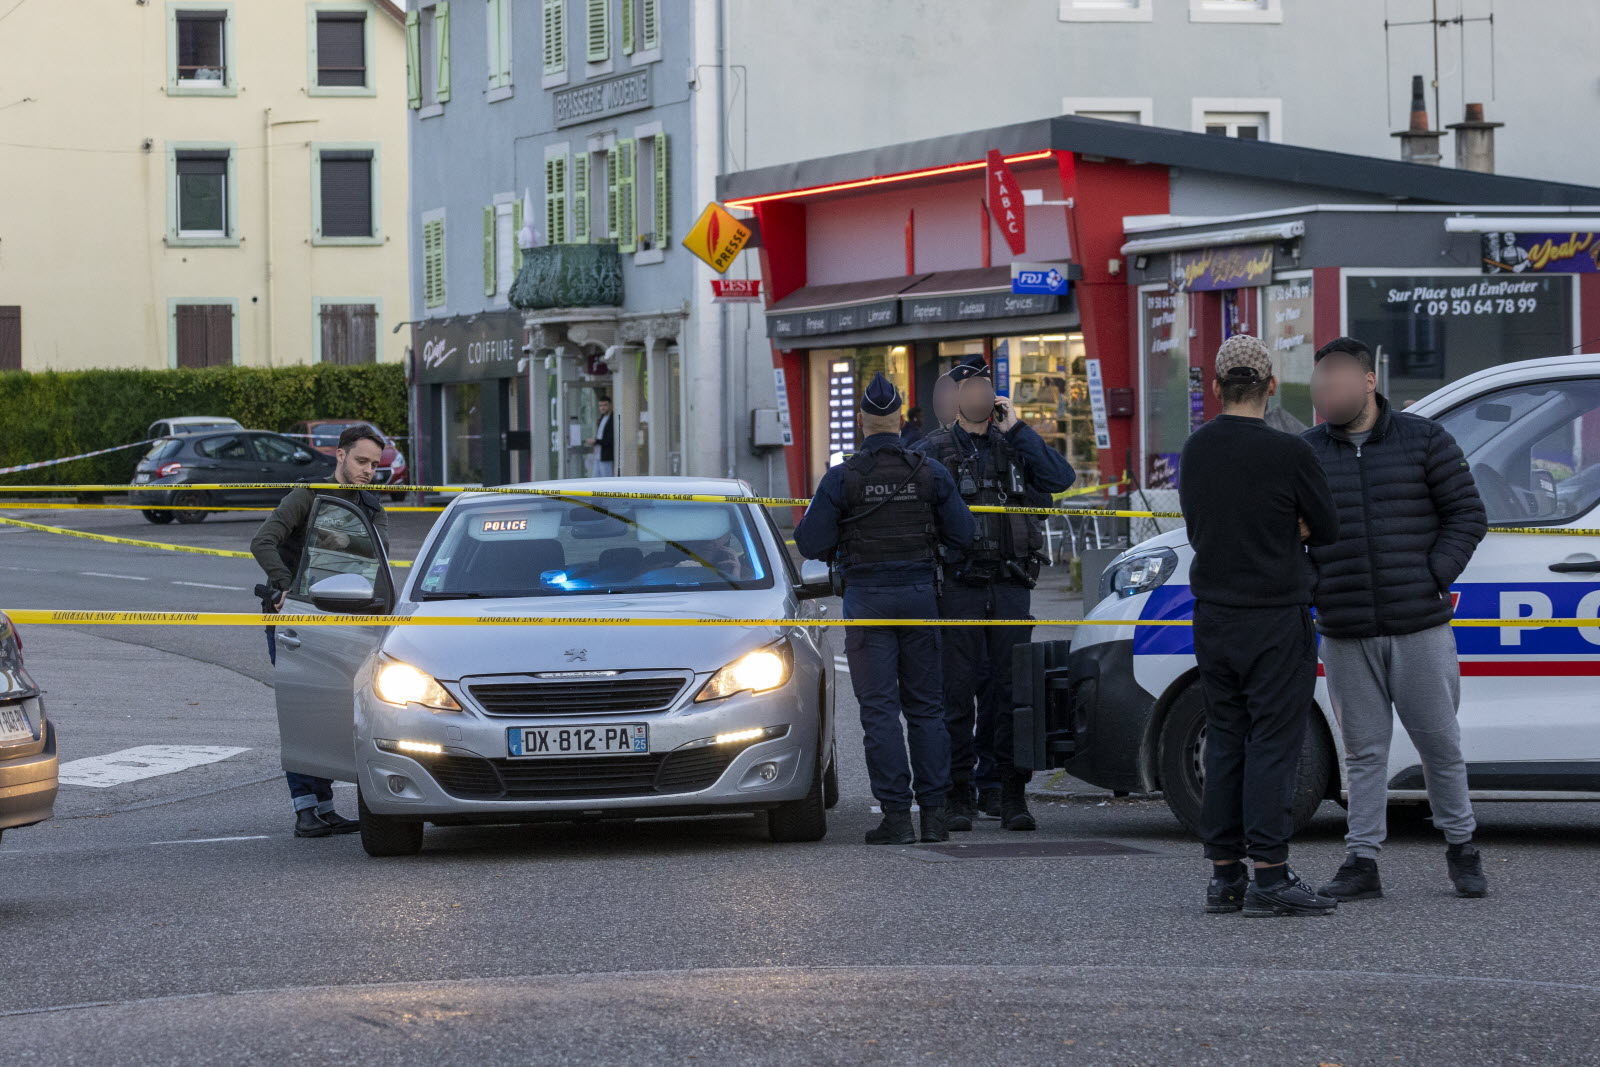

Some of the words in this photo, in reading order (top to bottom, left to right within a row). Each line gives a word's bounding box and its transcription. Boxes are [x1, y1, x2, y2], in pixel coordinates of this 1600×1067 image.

[556, 85, 604, 121] BRASSERIE
[607, 74, 648, 109] MODERNE
[994, 170, 1018, 233] TABAC
[715, 229, 746, 268] PRESSE
[1020, 273, 1042, 284] FDJ
[1387, 288, 1411, 303] Sur
[1413, 287, 1447, 301] Place
[1427, 301, 1448, 316] 09
[1452, 300, 1471, 314] 50
[1473, 299, 1493, 314] 64
[1496, 299, 1515, 313] 78
[1517, 298, 1537, 312] 99
[467, 338, 514, 365] COIFFURE
[484, 520, 528, 531] POLICE
[52, 611, 93, 620] INTERDITE
[95, 612, 116, 620] ZONE
[635, 739, 647, 751] 25
